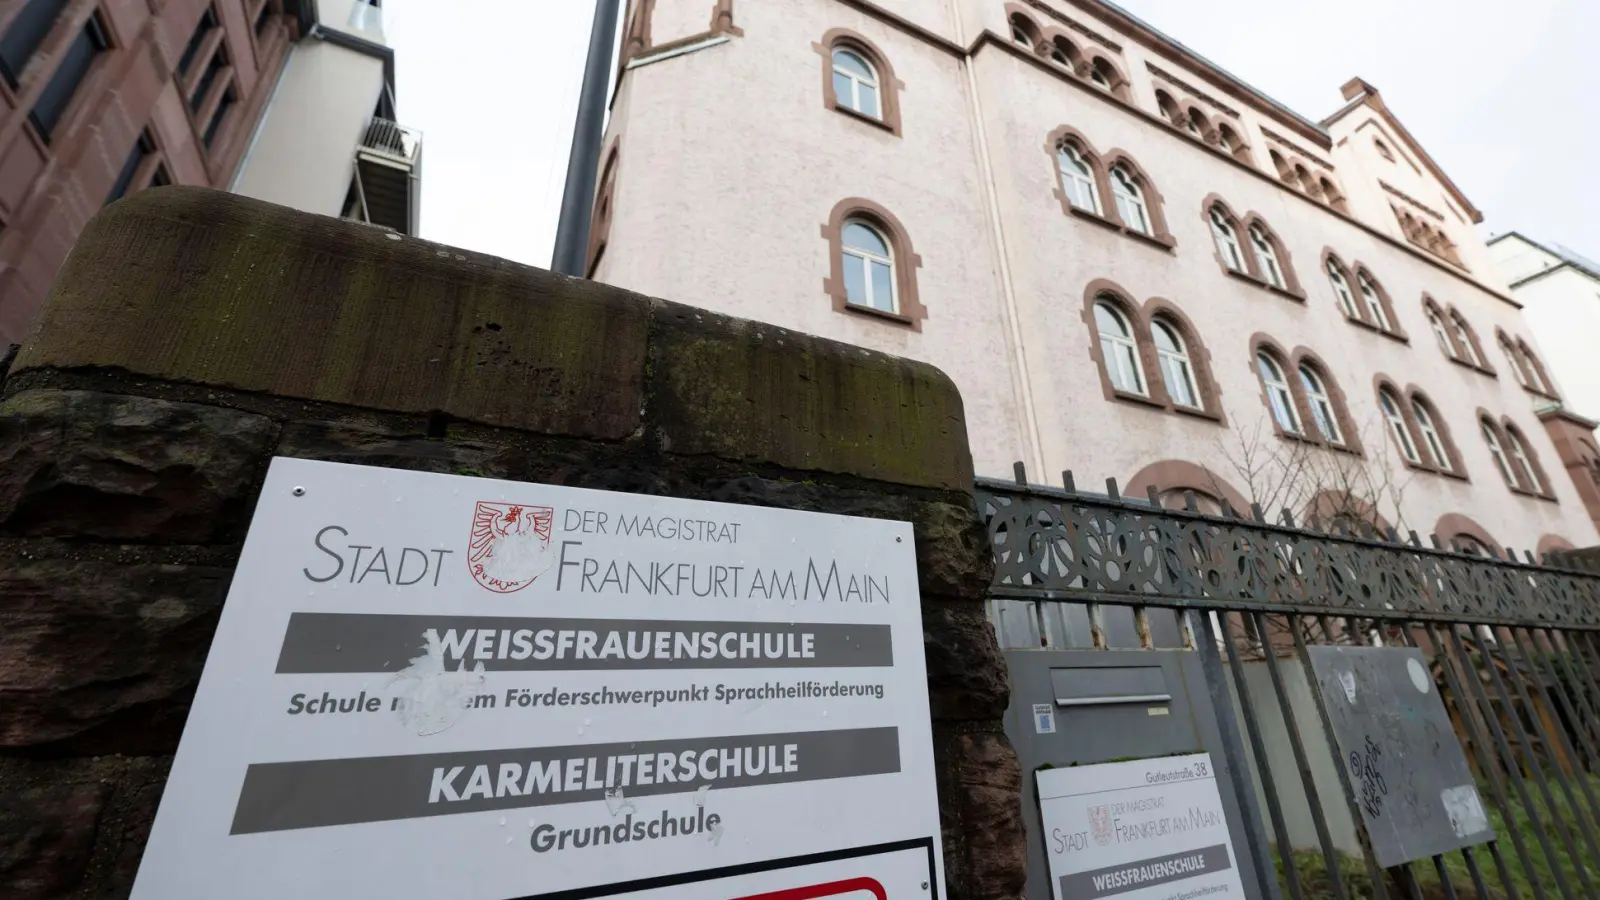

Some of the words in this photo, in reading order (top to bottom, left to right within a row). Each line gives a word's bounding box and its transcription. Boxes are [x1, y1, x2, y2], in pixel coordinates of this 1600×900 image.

[564, 508, 608, 534] DER
[615, 514, 741, 544] MAGISTRAT
[303, 525, 453, 586] STADT
[556, 540, 744, 598] FRANKFURT
[748, 568, 797, 600] AM
[804, 557, 890, 603] MAIN
[427, 628, 816, 661] WEISSFRAUENSCHULE
[287, 691, 381, 715] Schule
[505, 685, 709, 709] Förderschwerpunkt
[715, 681, 884, 704] Sprachheilförderung
[428, 743, 798, 803] KARMELITERSCHULE
[1145, 766, 1194, 783] Gutleutstraße
[1194, 762, 1208, 777] 38
[530, 807, 721, 853] Grundschule
[1053, 828, 1088, 854] STADT
[1113, 818, 1171, 844] FRANKFURT
[1092, 854, 1206, 891] WEISSFRAUENSCHULE
